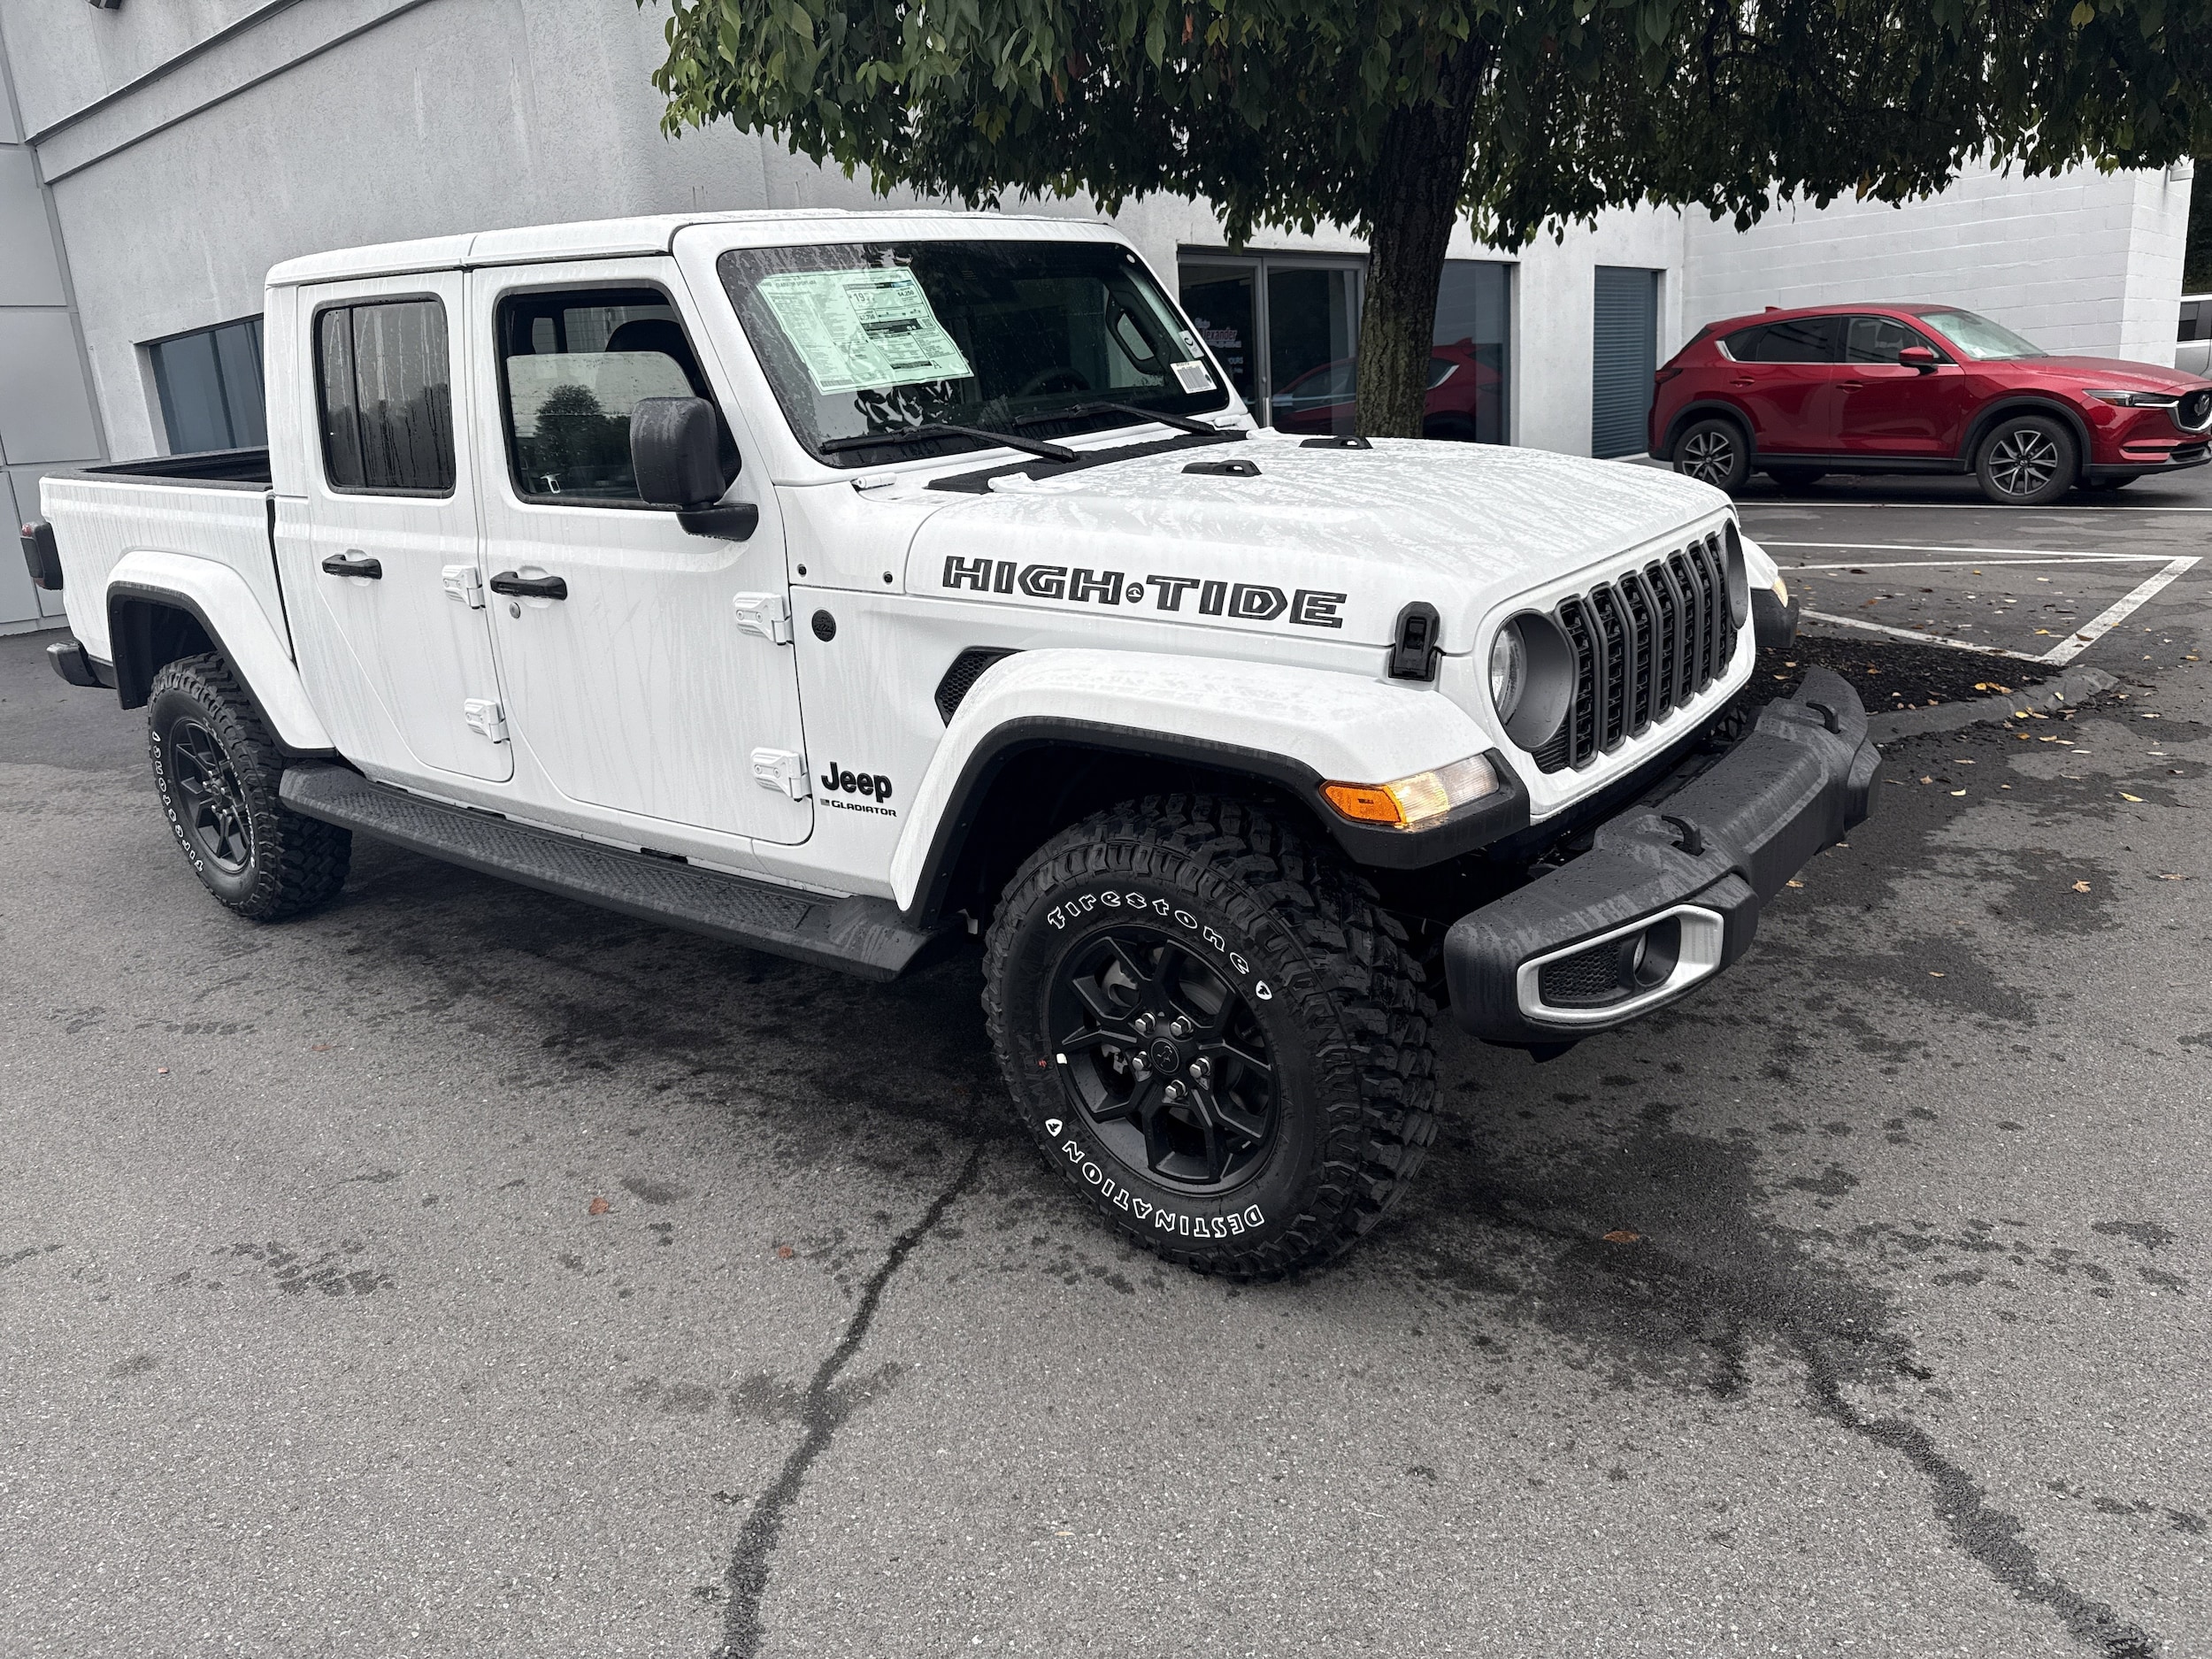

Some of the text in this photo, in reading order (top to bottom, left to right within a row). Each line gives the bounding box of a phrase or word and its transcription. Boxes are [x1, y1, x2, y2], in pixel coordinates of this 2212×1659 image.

[854, 292, 865, 303] 19
[942, 555, 1348, 628] HIGH TIDE
[821, 762, 892, 803] Jeep
[831, 800, 897, 817] GLADIATOR
[1048, 890, 1249, 974] Firestone
[1063, 1141, 1264, 1239] DESTINATION
